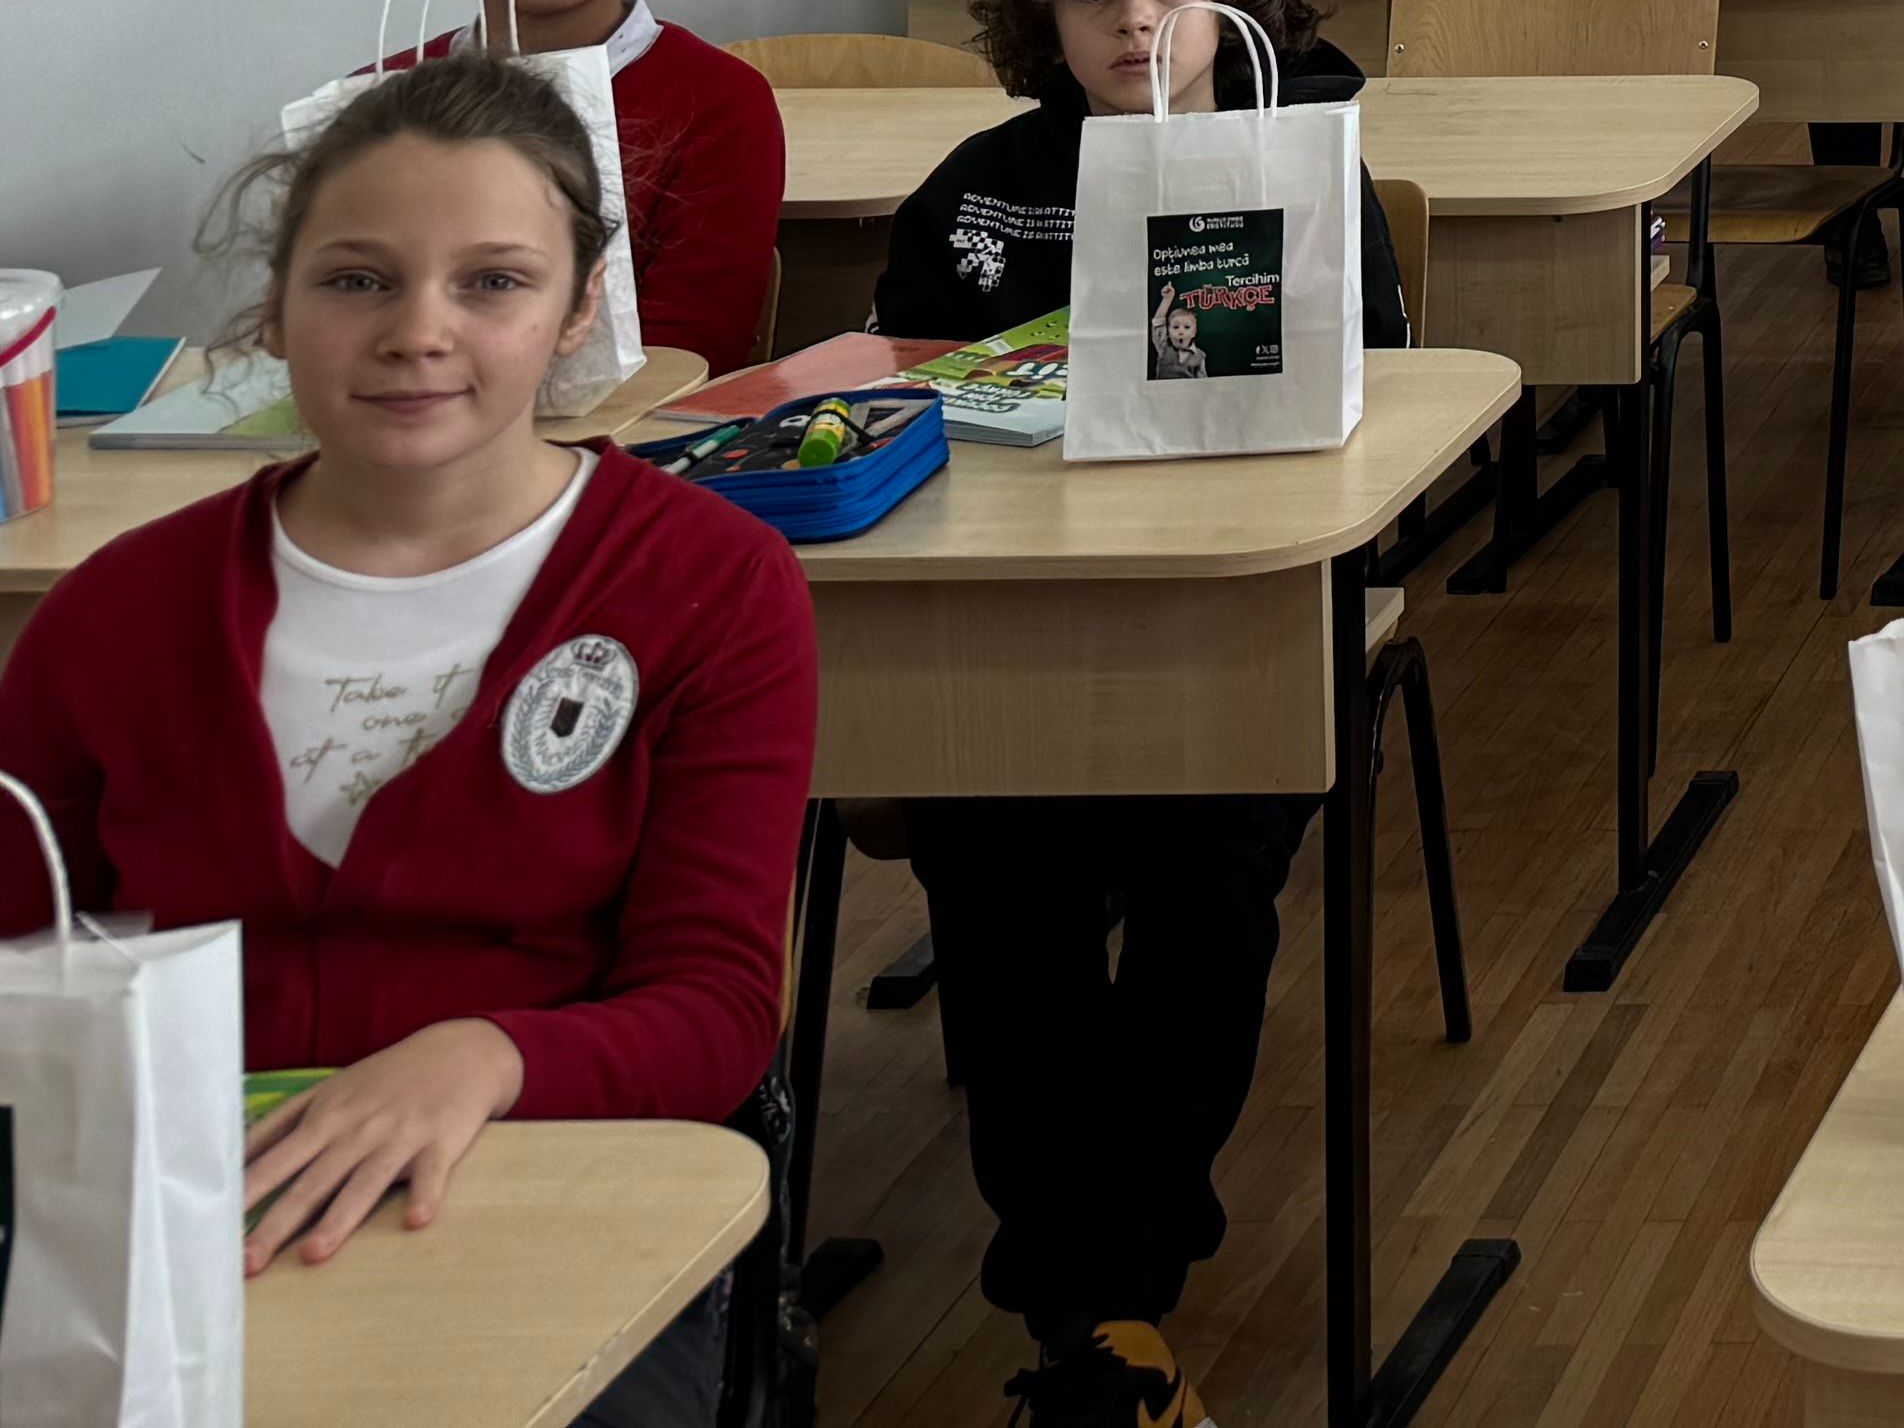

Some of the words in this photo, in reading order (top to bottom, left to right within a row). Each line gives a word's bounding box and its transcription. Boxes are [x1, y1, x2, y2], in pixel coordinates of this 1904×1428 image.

[1208, 242, 1234, 253] mea
[1153, 263, 1181, 277] este
[1225, 272, 1280, 287] Tercihim
[1180, 284, 1275, 311] TÜRKÇE
[325, 673, 407, 713] Take
[362, 711, 428, 731] one
[289, 737, 347, 784] at
